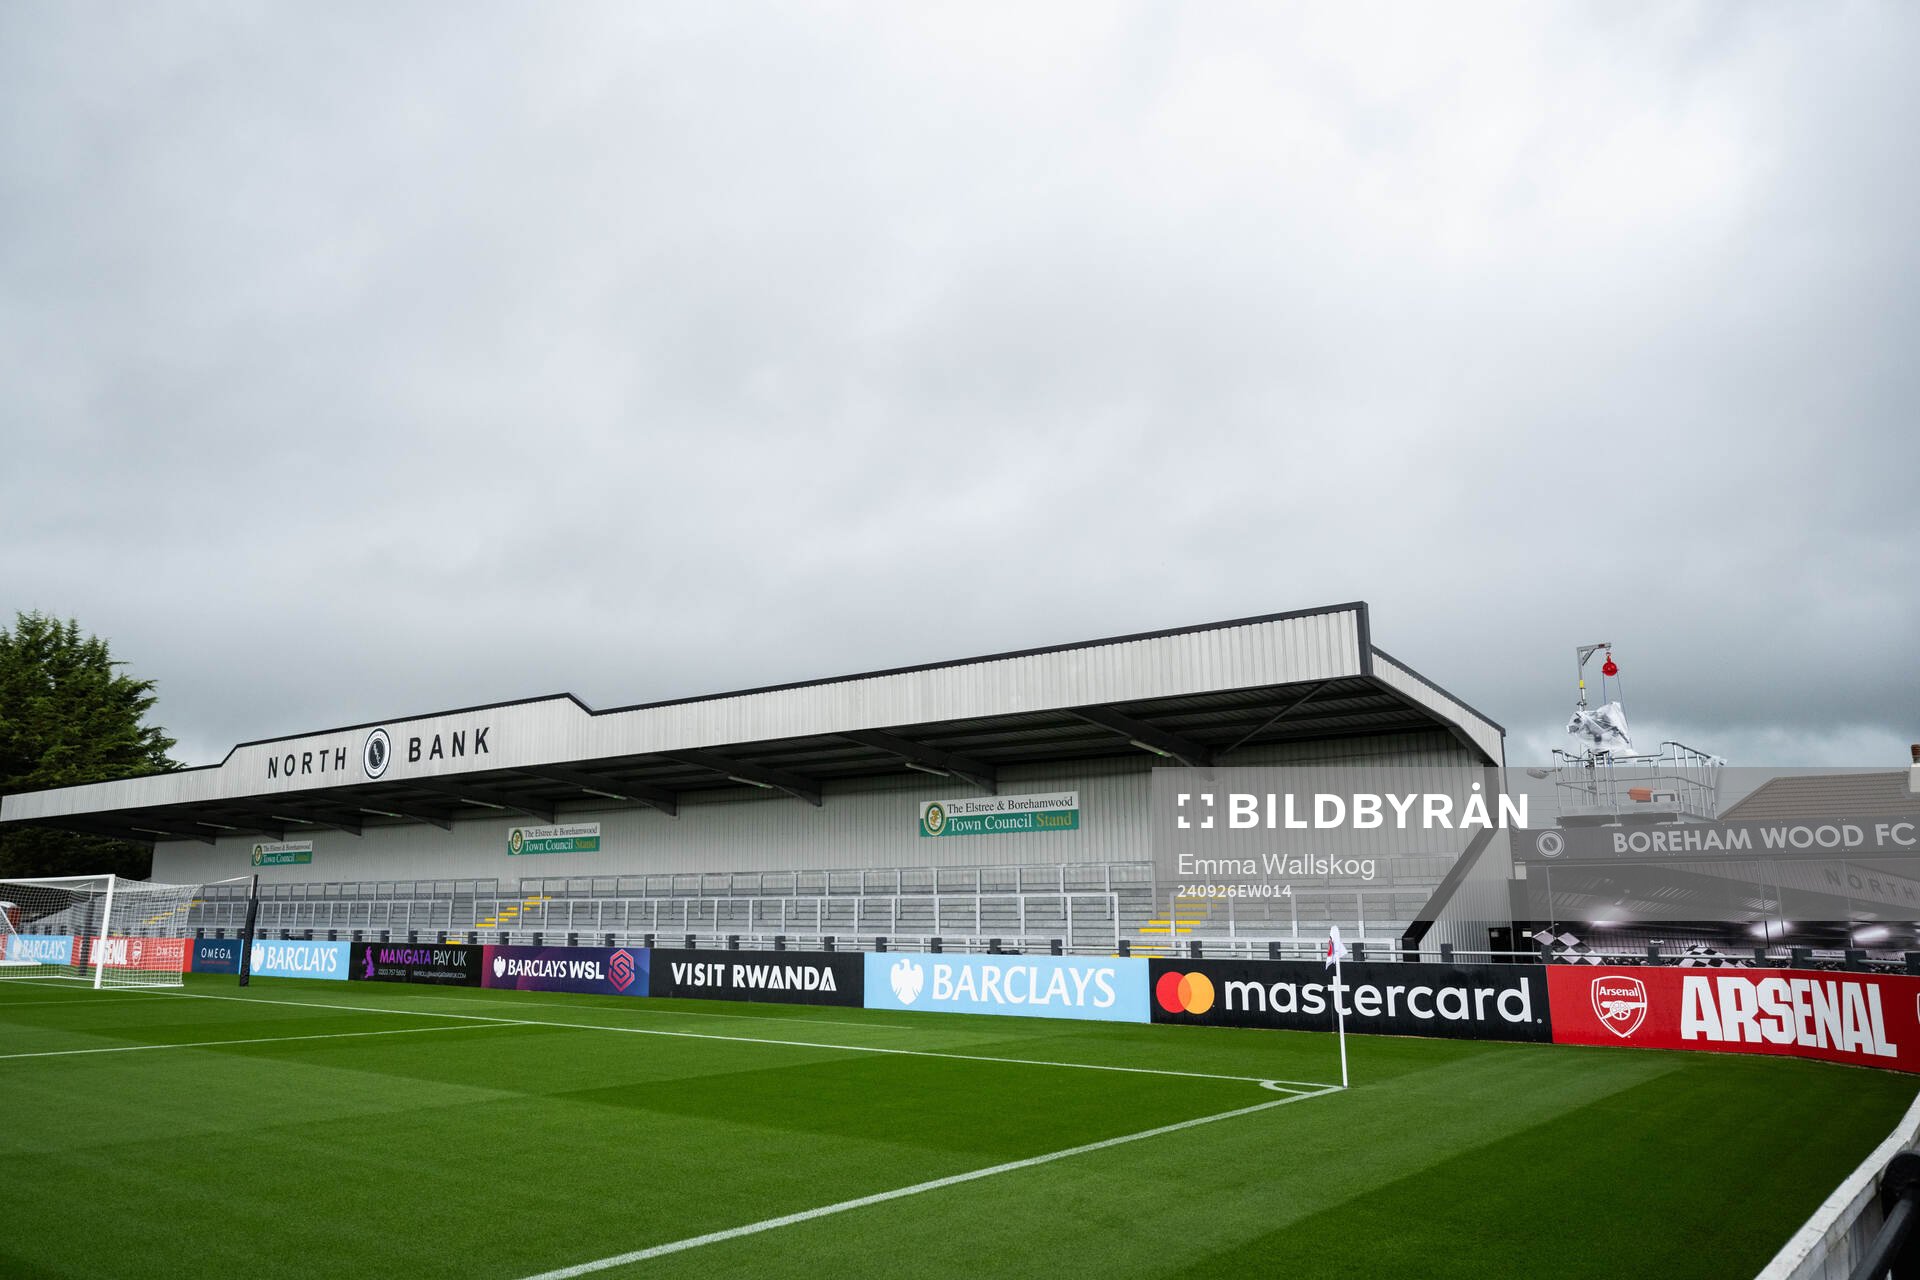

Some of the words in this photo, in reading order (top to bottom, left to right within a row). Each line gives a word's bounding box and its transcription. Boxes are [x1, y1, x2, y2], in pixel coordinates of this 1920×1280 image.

[267, 746, 347, 779] NORTH
[408, 726, 490, 763] BANK
[947, 803, 964, 814] The
[965, 799, 995, 813] Elstree
[997, 801, 1005, 811] &
[1008, 796, 1073, 810] Borehamwood
[949, 818, 981, 832] Town
[984, 814, 1032, 830] Council
[1036, 811, 1072, 827] Stand
[526, 841, 544, 851] Town
[545, 838, 573, 850] Council
[1613, 828, 1752, 853] BOREHAM
[1760, 825, 1864, 849] WOOD
[1876, 822, 1917, 846] FC
[201, 947, 232, 959] OMEGA
[266, 943, 338, 972] BARCLAYS
[380, 948, 431, 965] MANGATA
[433, 950, 452, 966] PAY
[452, 950, 467, 966] UK
[507, 960, 567, 978] BARCLAYS
[569, 960, 604, 980] WSL
[671, 963, 725, 987] VISIT
[732, 964, 837, 992] RWANDA
[932, 963, 1116, 1008] BARCLAYS
[1599, 986, 1639, 997] Arsenal
[1224, 976, 1532, 1023] mastercard
[1680, 975, 1898, 1058] ARSENAL
